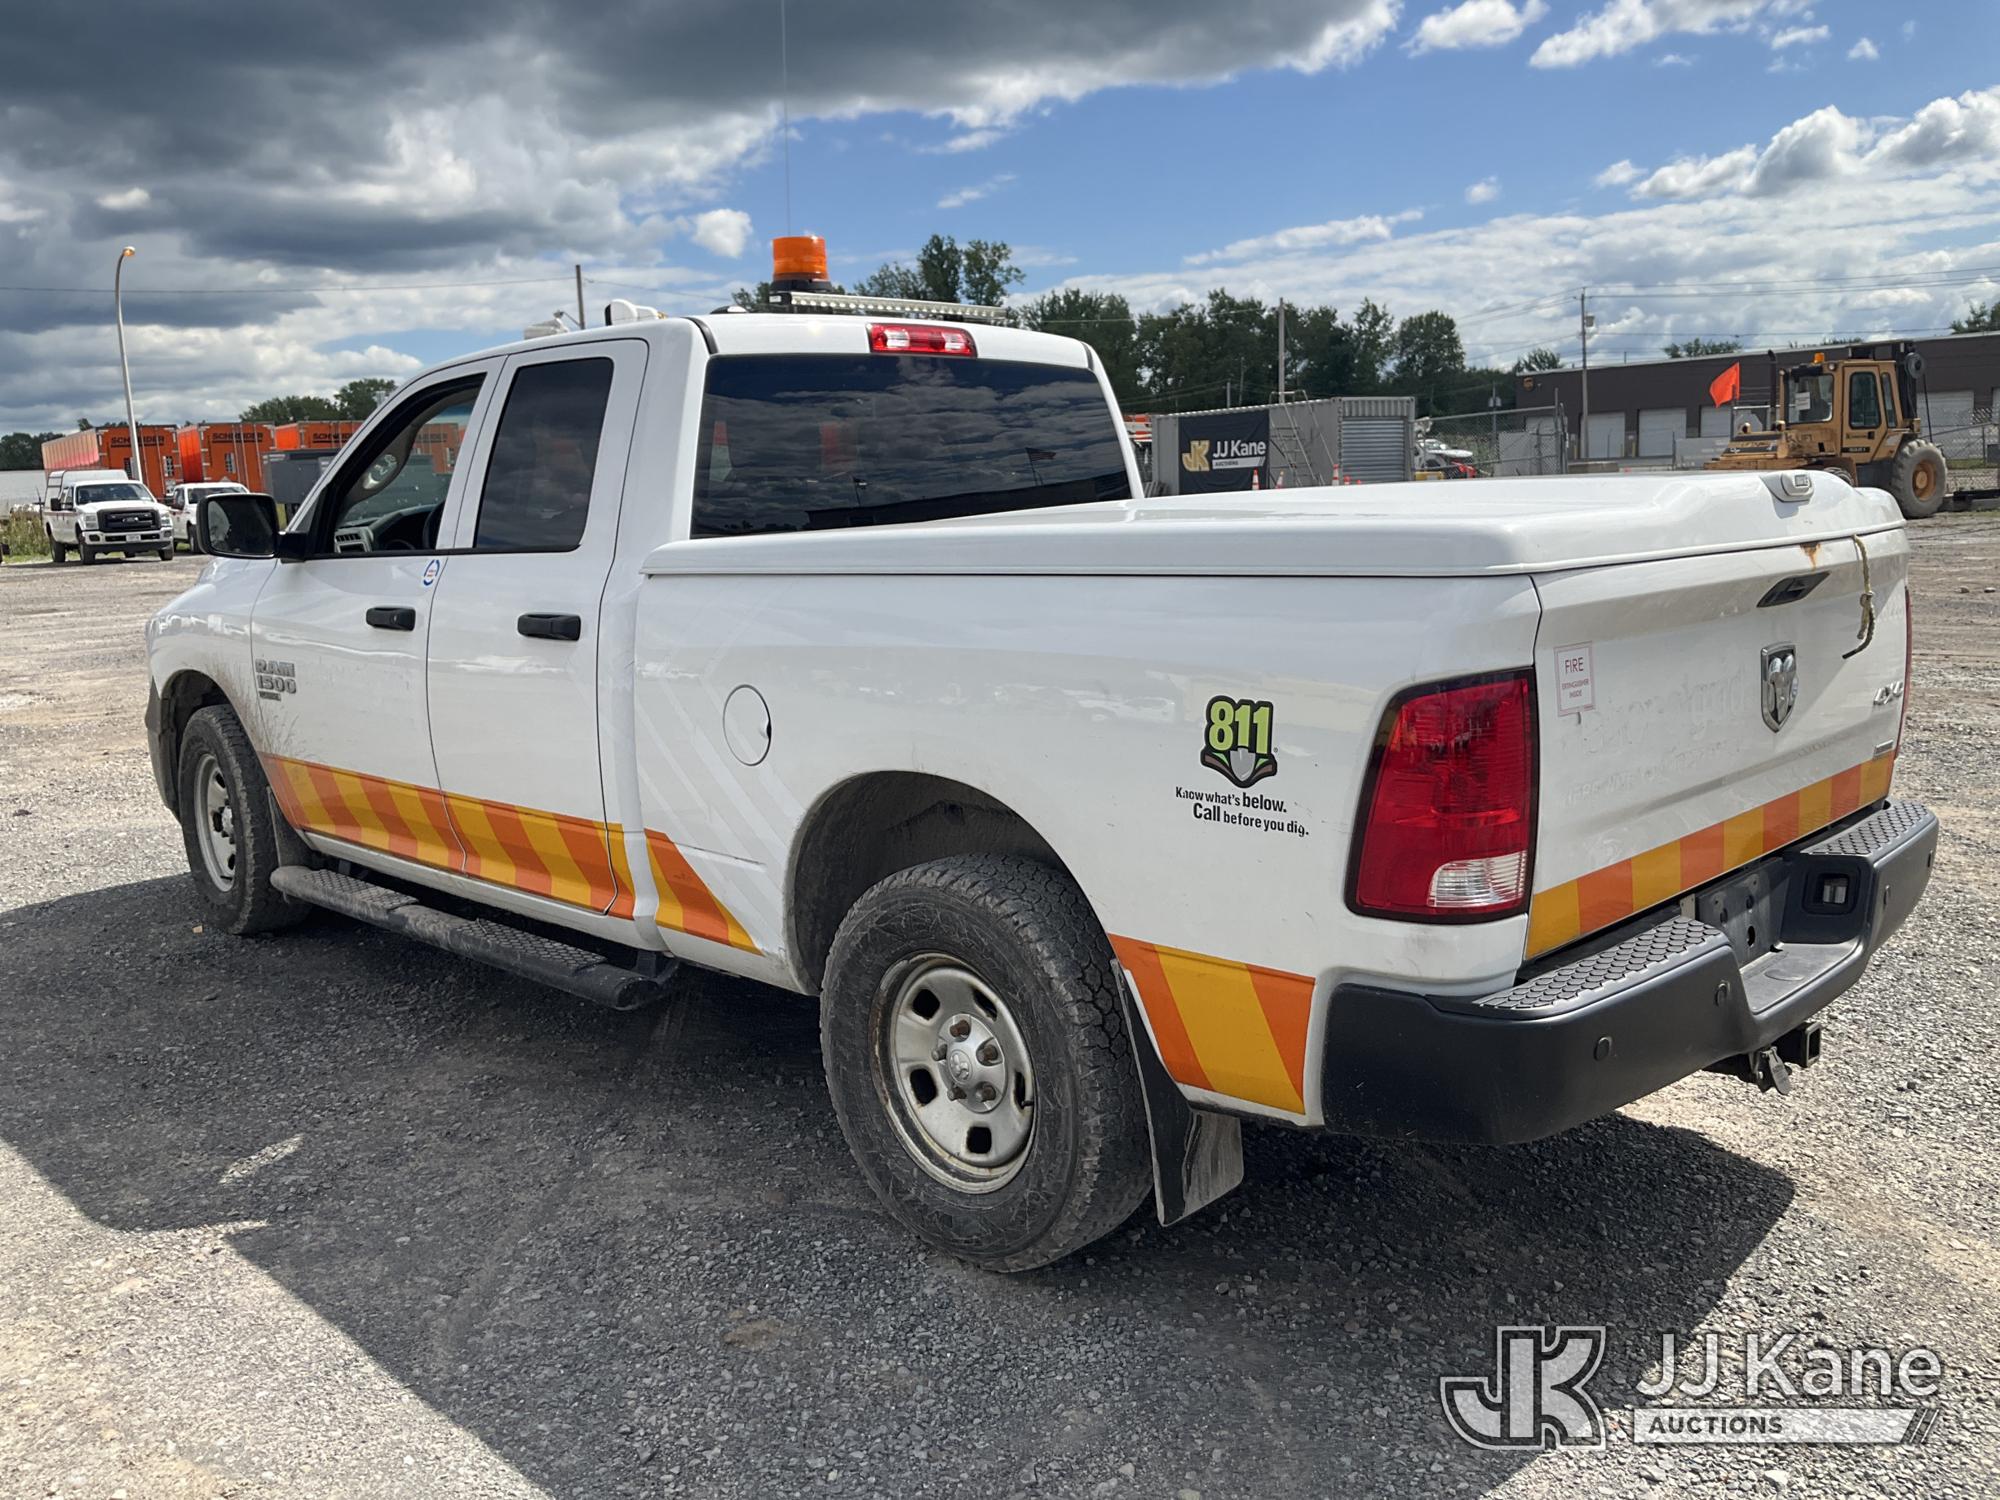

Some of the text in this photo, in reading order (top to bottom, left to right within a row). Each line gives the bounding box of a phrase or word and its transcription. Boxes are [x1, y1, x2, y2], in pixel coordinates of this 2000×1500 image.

[1213, 440, 1266, 458] JJ Kane
[255, 659, 295, 677] RAM
[1565, 657, 1584, 674] FIRE
[257, 675, 297, 694] 1500
[1207, 698, 1271, 755] 811
[1176, 786, 1287, 813] Know what's below.
[1193, 803, 1309, 837] Call before you dig.
